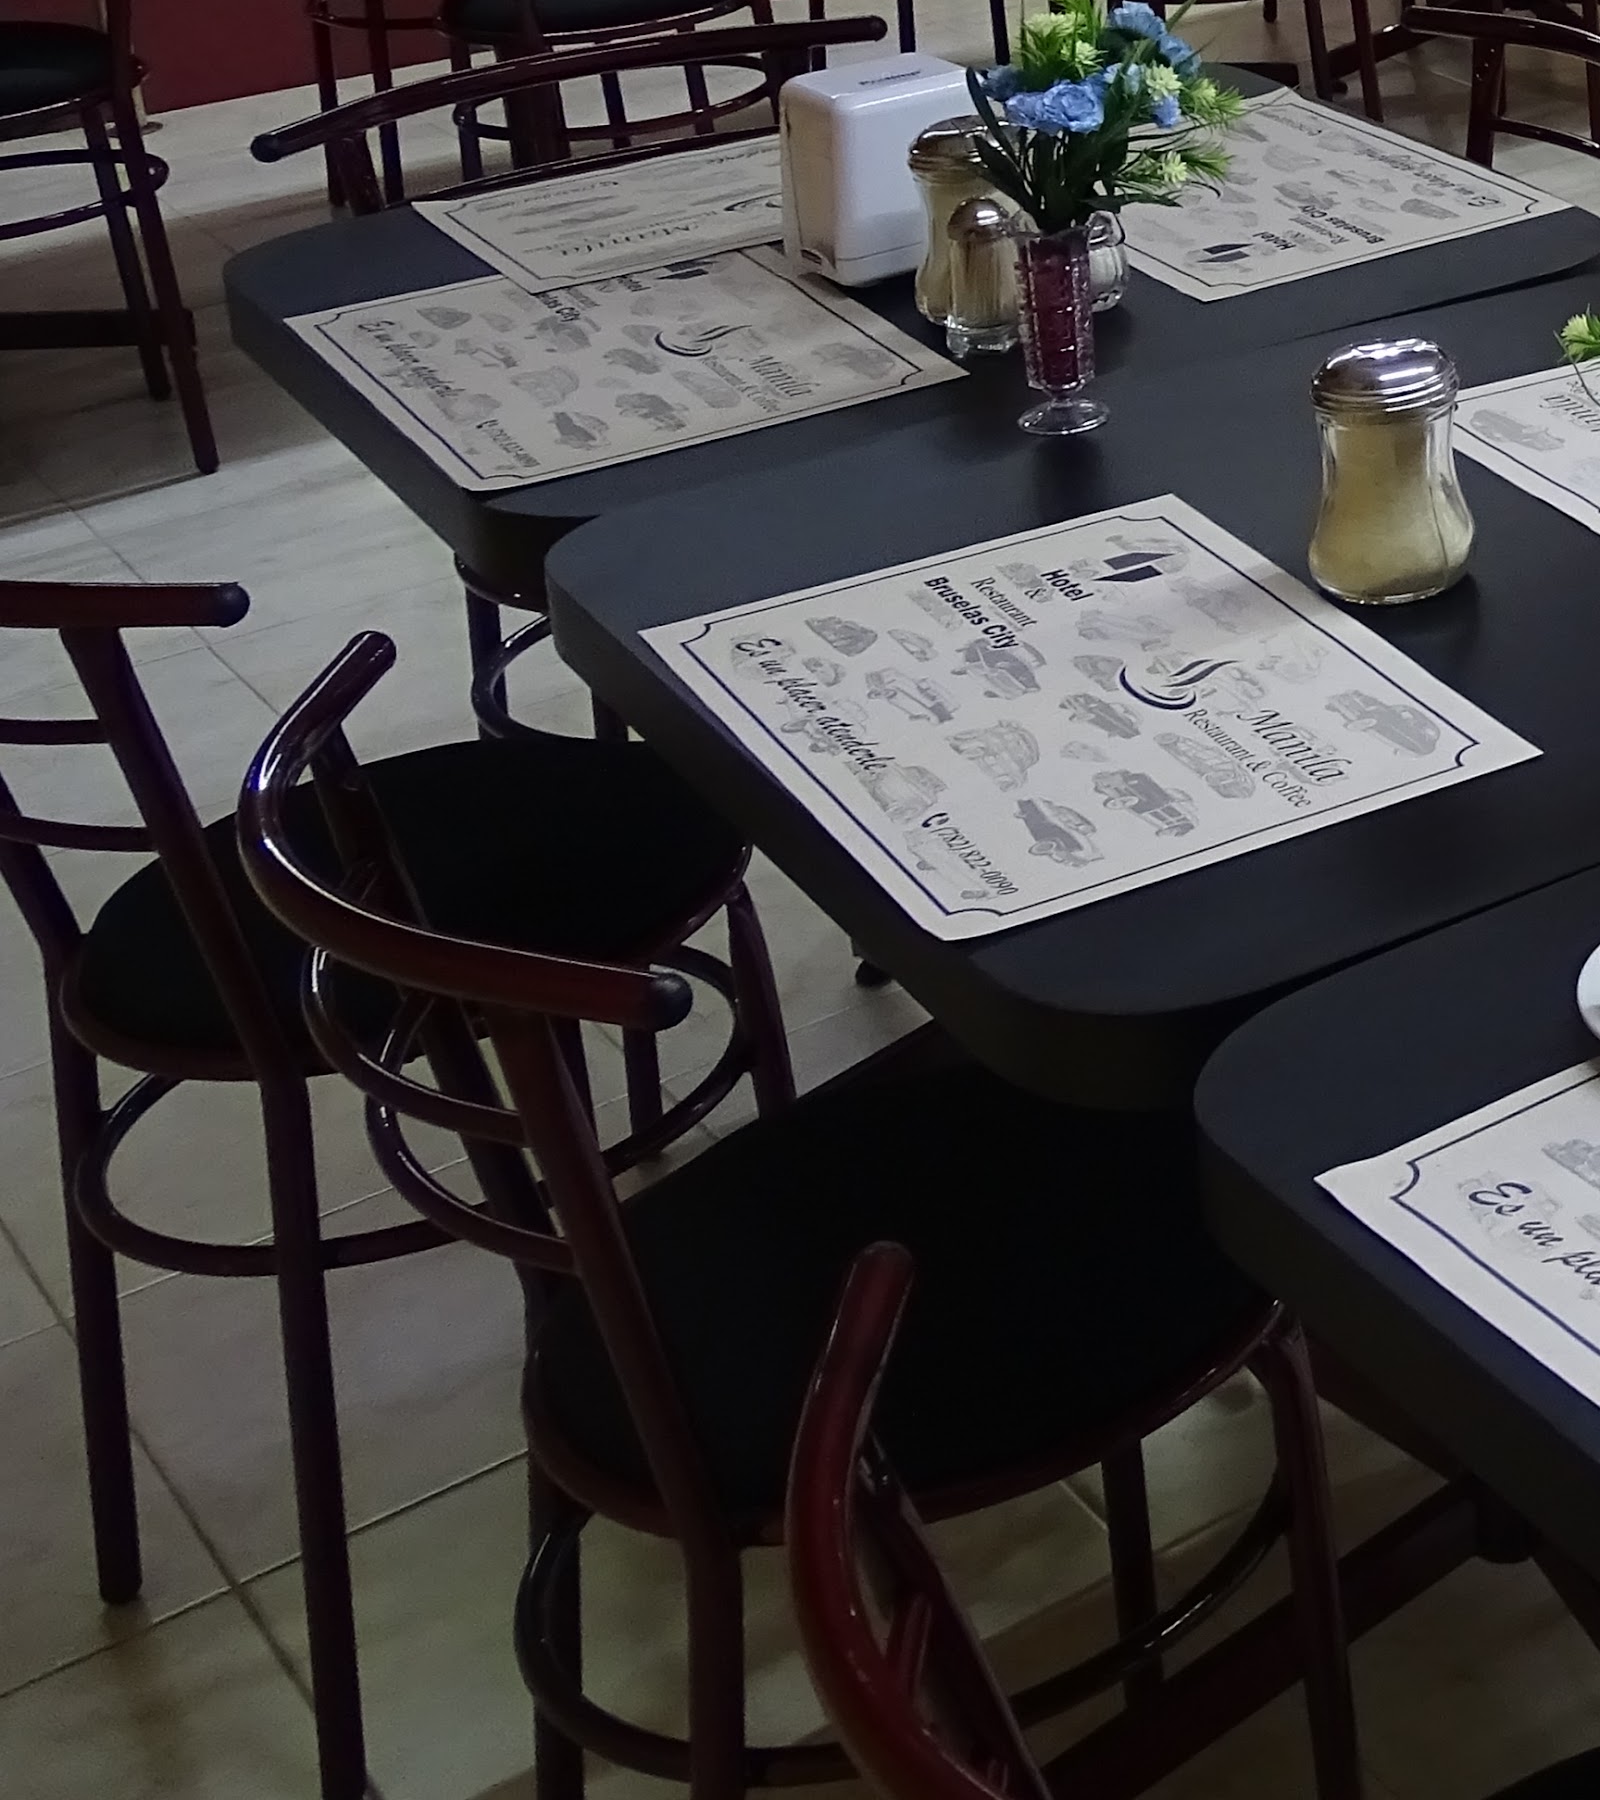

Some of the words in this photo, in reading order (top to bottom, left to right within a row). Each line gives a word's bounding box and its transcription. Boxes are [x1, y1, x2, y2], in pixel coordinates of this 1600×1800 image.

[1252, 231, 1297, 251] Hotel
[1325, 216, 1385, 245] Bruselas
[969, 577, 1038, 628] Restaurant
[1040, 569, 1094, 602] Hotel
[924, 577, 989, 627] Bruselas
[982, 624, 1019, 650] City
[735, 638, 782, 658] Es
[758, 660, 787, 675] un
[763, 677, 826, 715] placer
[1183, 708, 1255, 762] Restaurant
[1246, 760, 1272, 773] &
[1262, 771, 1311, 808] Coffee
[1236, 710, 1352, 781] Manila
[930, 827, 976, 851] (782)
[959, 850, 1019, 895] 822-0090
[1469, 1182, 1533, 1216] Es
[1518, 1221, 1564, 1248] un
